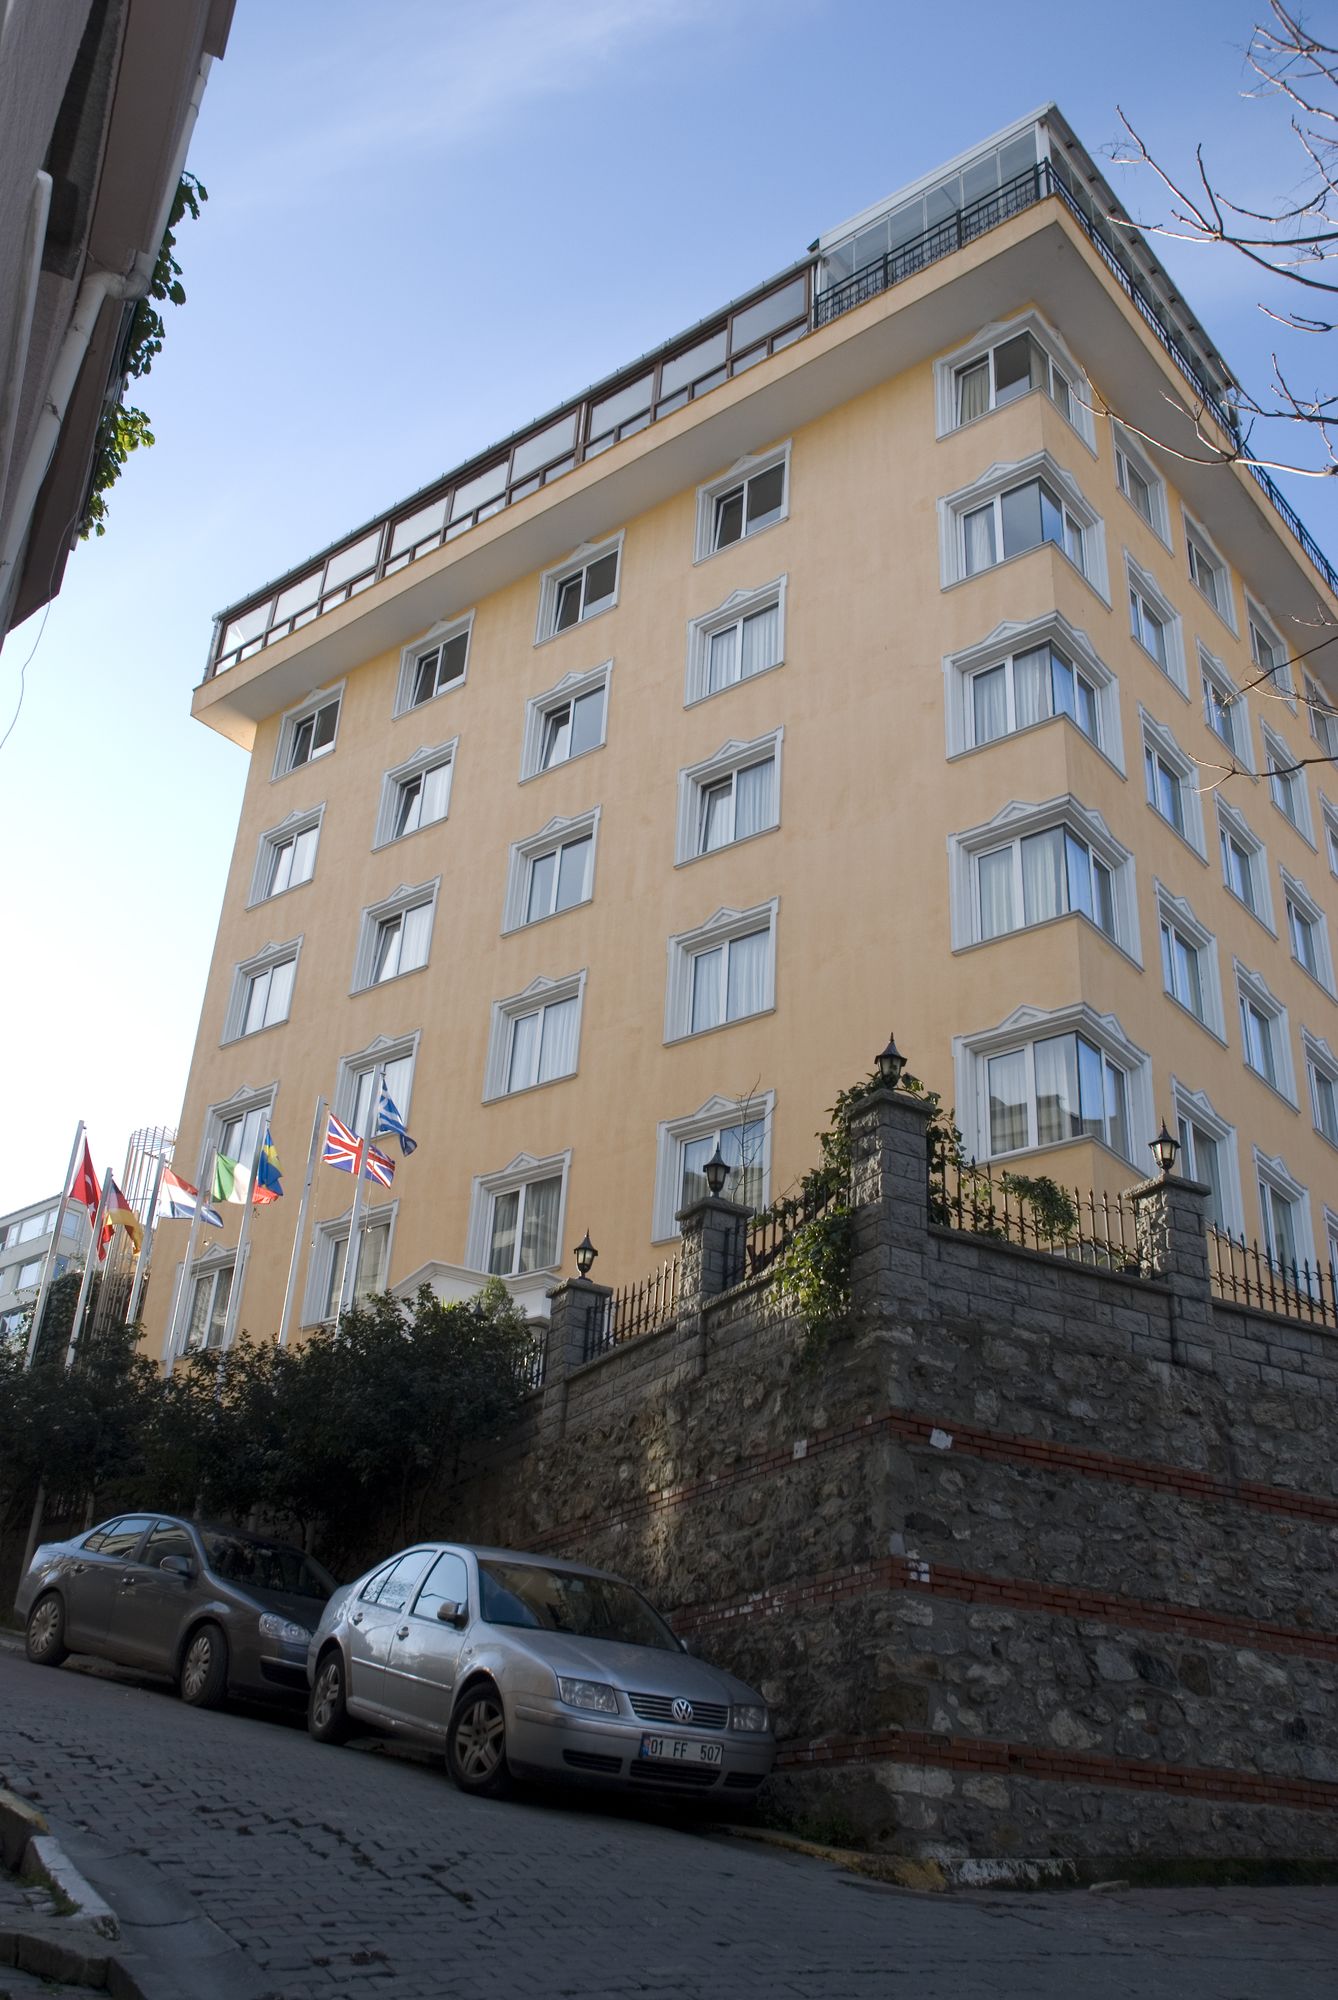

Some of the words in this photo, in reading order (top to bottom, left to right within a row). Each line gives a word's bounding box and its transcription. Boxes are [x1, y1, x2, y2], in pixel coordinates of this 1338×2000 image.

[651, 1739, 664, 1755] 01
[673, 1741, 688, 1758] FF
[700, 1744, 720, 1762] 507
